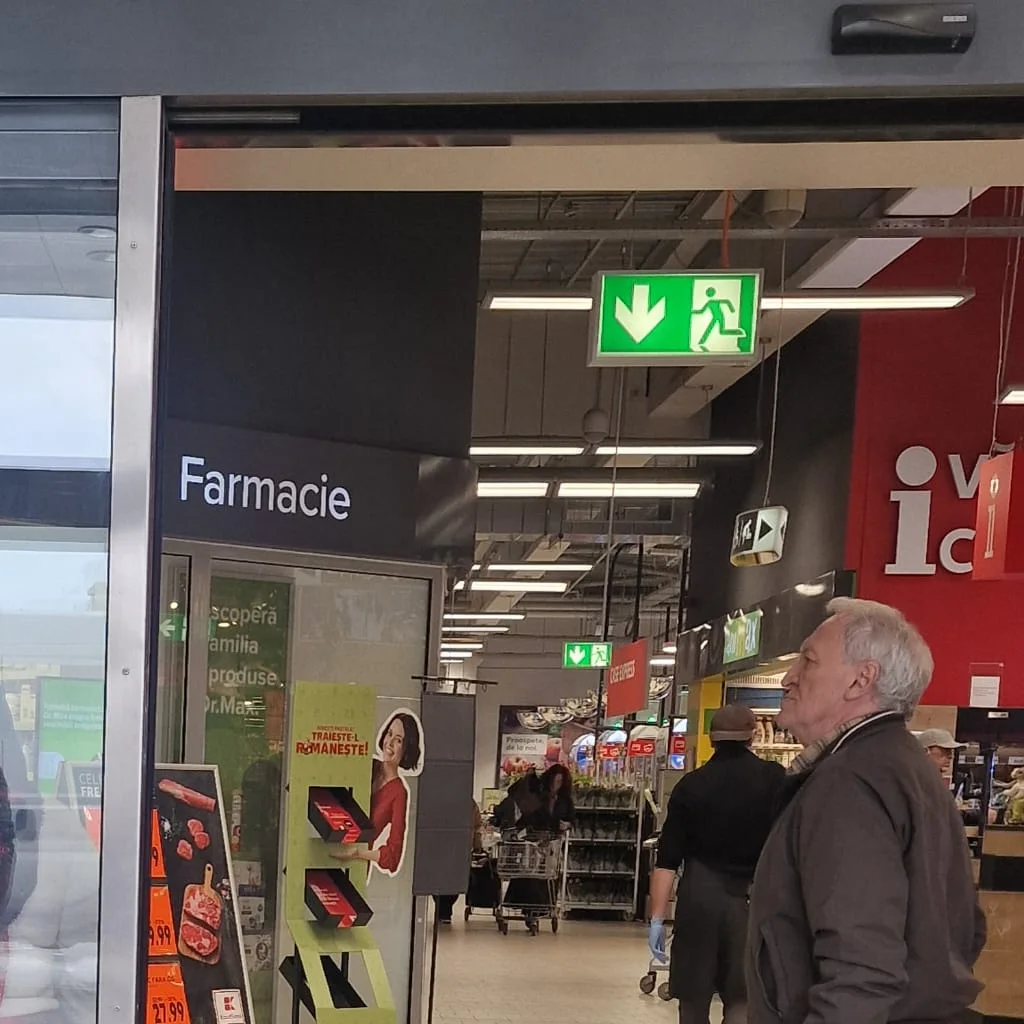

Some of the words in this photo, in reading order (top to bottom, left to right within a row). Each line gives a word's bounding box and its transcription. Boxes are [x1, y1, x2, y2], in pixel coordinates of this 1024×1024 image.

[180, 455, 351, 520] Farmacie
[209, 606, 277, 627] scoperă
[209, 635, 259, 655] amilia
[209, 665, 278, 688] produse
[79, 772, 102, 785] CEL
[80, 786, 101, 798] FRE
[152, 1002, 184, 1024] 27.99
